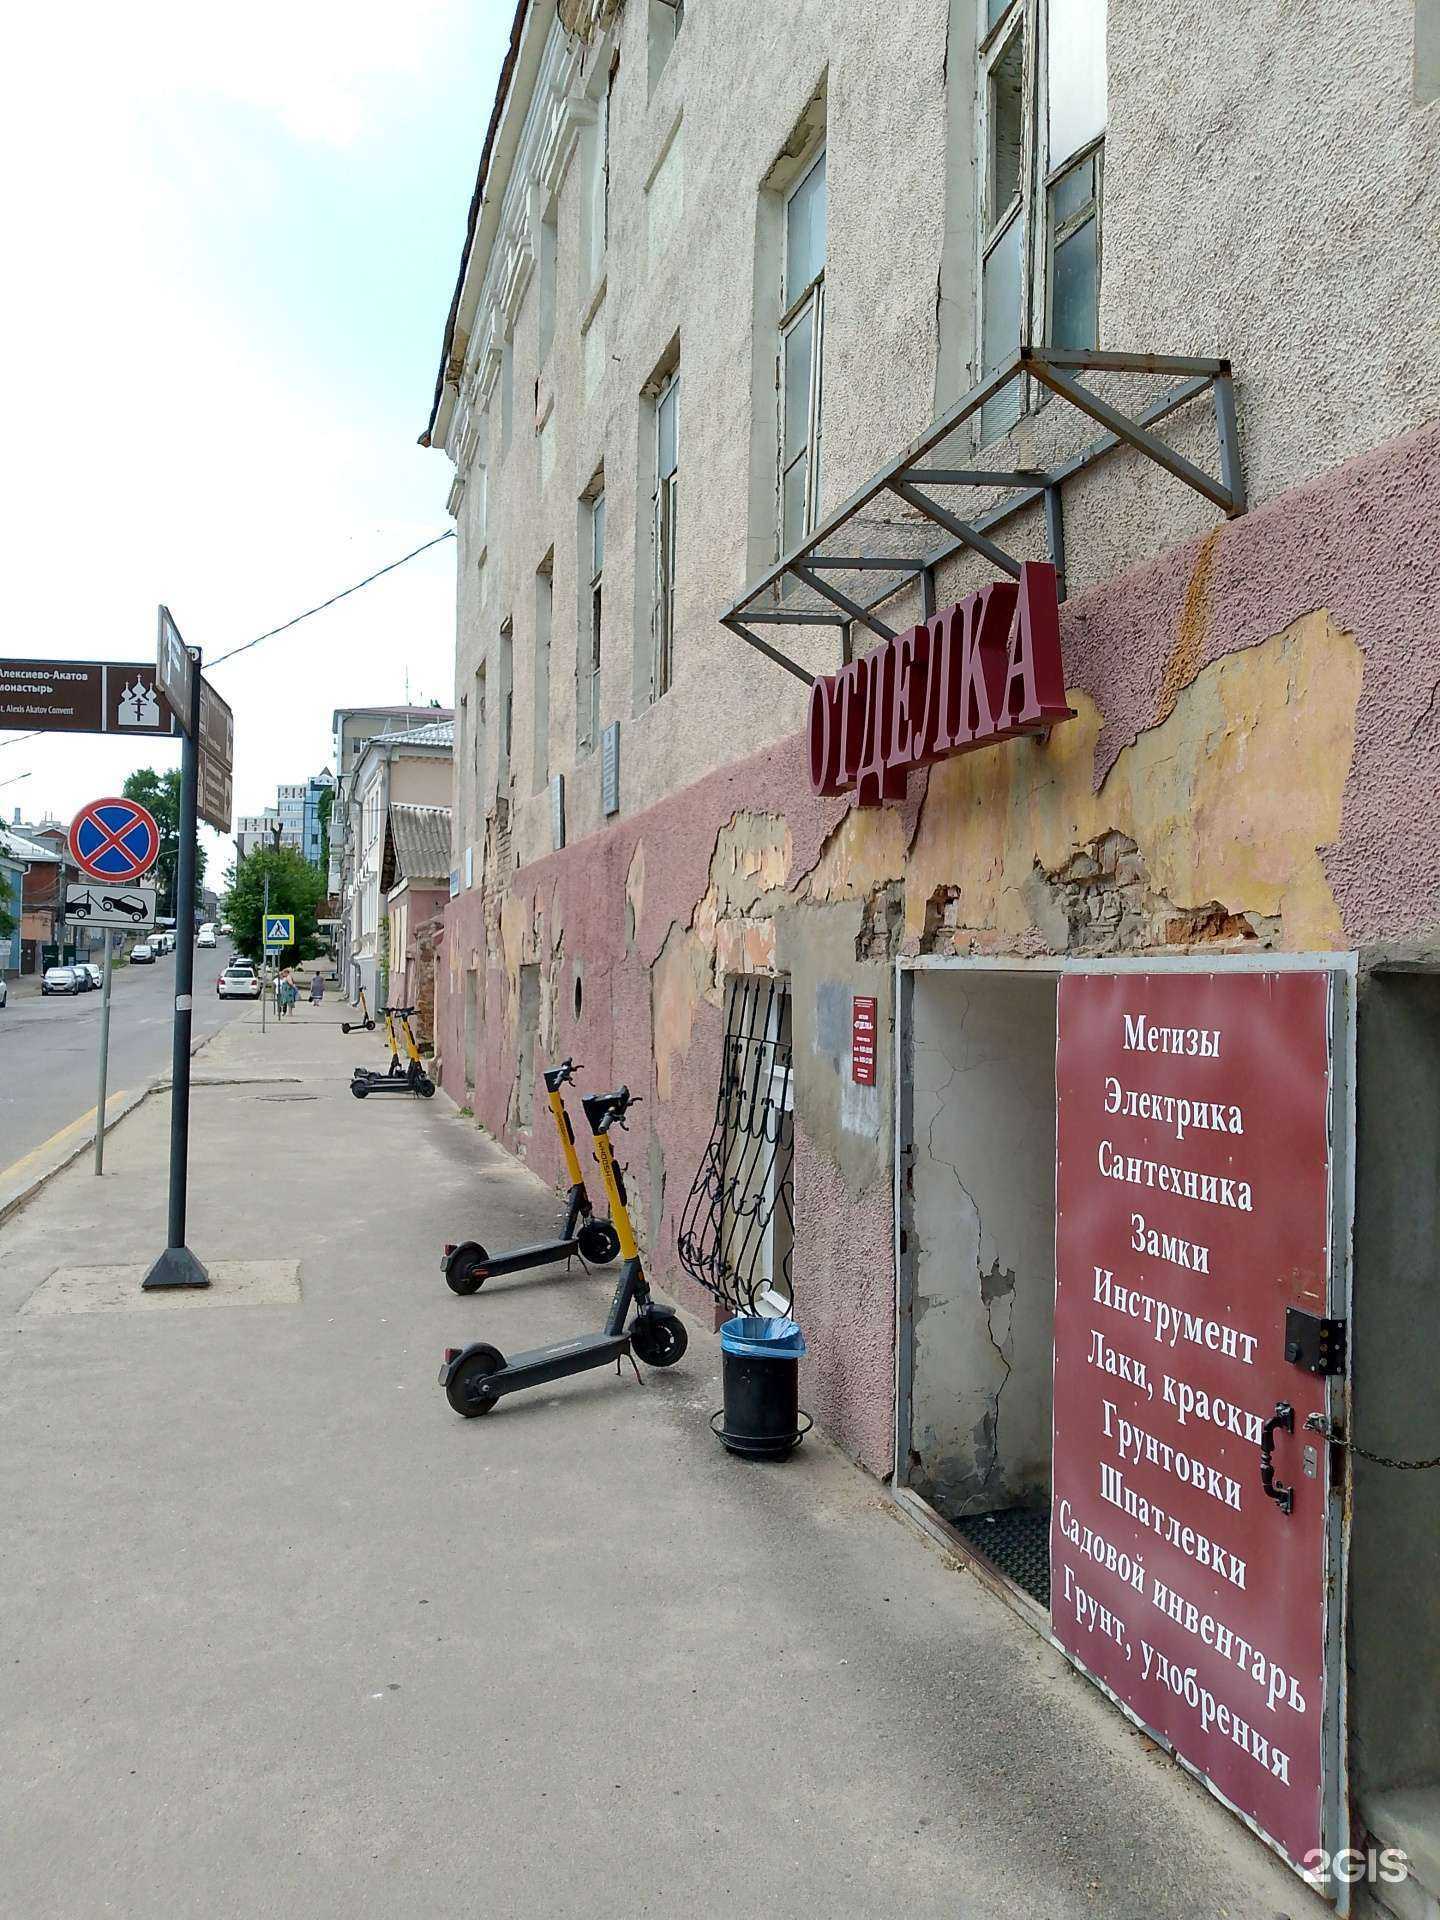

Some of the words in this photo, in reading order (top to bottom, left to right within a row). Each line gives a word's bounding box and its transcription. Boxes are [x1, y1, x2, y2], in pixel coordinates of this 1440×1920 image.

[806, 561, 1050, 804] ОТДЕЛКА
[1122, 1014, 1221, 1058] Метизы
[1104, 1076, 1244, 1140] Электрика
[1098, 1140, 1253, 1212] Сантехника
[1131, 1212, 1210, 1275] Замки
[1092, 1266, 1258, 1365] Инструмент
[1087, 1329, 1153, 1400] Лаки,
[1162, 1373, 1265, 1446] краски
[1102, 1399, 1242, 1512] Грунтовки
[1100, 1462, 1247, 1591] Шпатлевки
[1059, 1499, 1146, 1595] Садовой
[1151, 1578, 1307, 1714] инвентарь
[1063, 1563, 1132, 1661] Грунт,
[1140, 1639, 1291, 1787] удобрения
